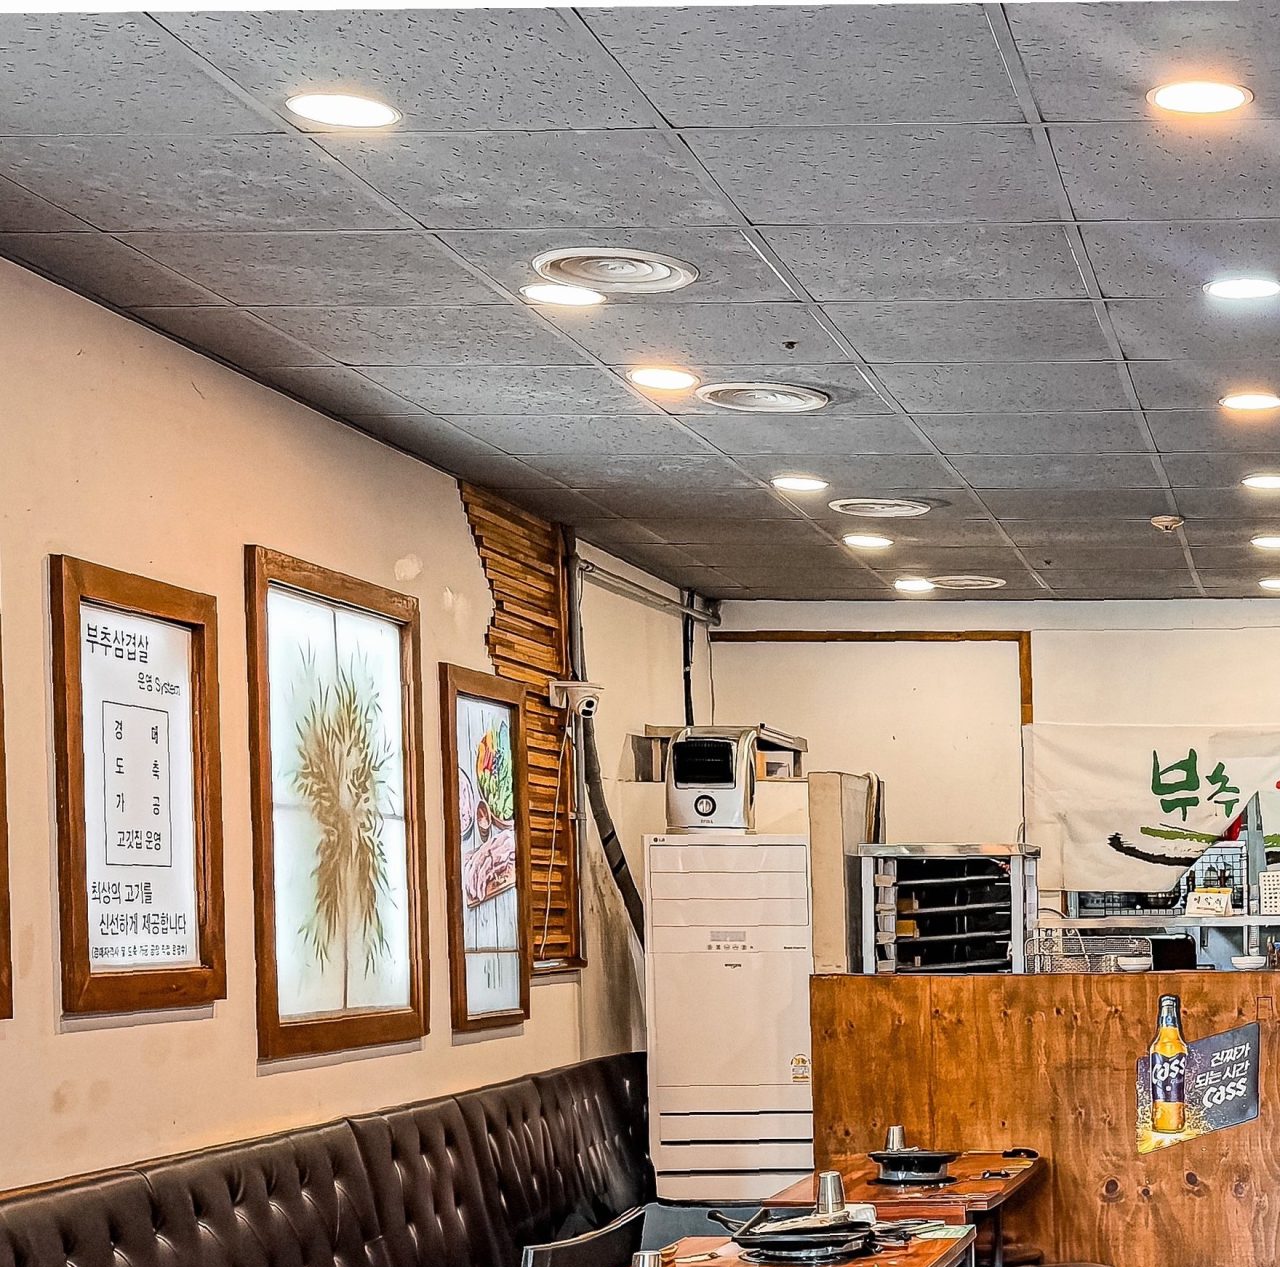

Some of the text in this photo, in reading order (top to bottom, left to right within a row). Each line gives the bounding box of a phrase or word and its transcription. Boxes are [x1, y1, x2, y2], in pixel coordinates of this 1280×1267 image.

[86, 623, 149, 664] 부추삼겹살
[137, 672, 153, 692] 운영
[1150, 748, 1240, 821] 부추
[117, 829, 161, 851] 고깃집 운영
[91, 881, 152, 905] 최상의 고기를
[99, 912, 187, 936] 신선하게 제공합니다
[1210, 1042, 1250, 1067] 진짜가
[1194, 1060, 1250, 1089] 되는 시간
